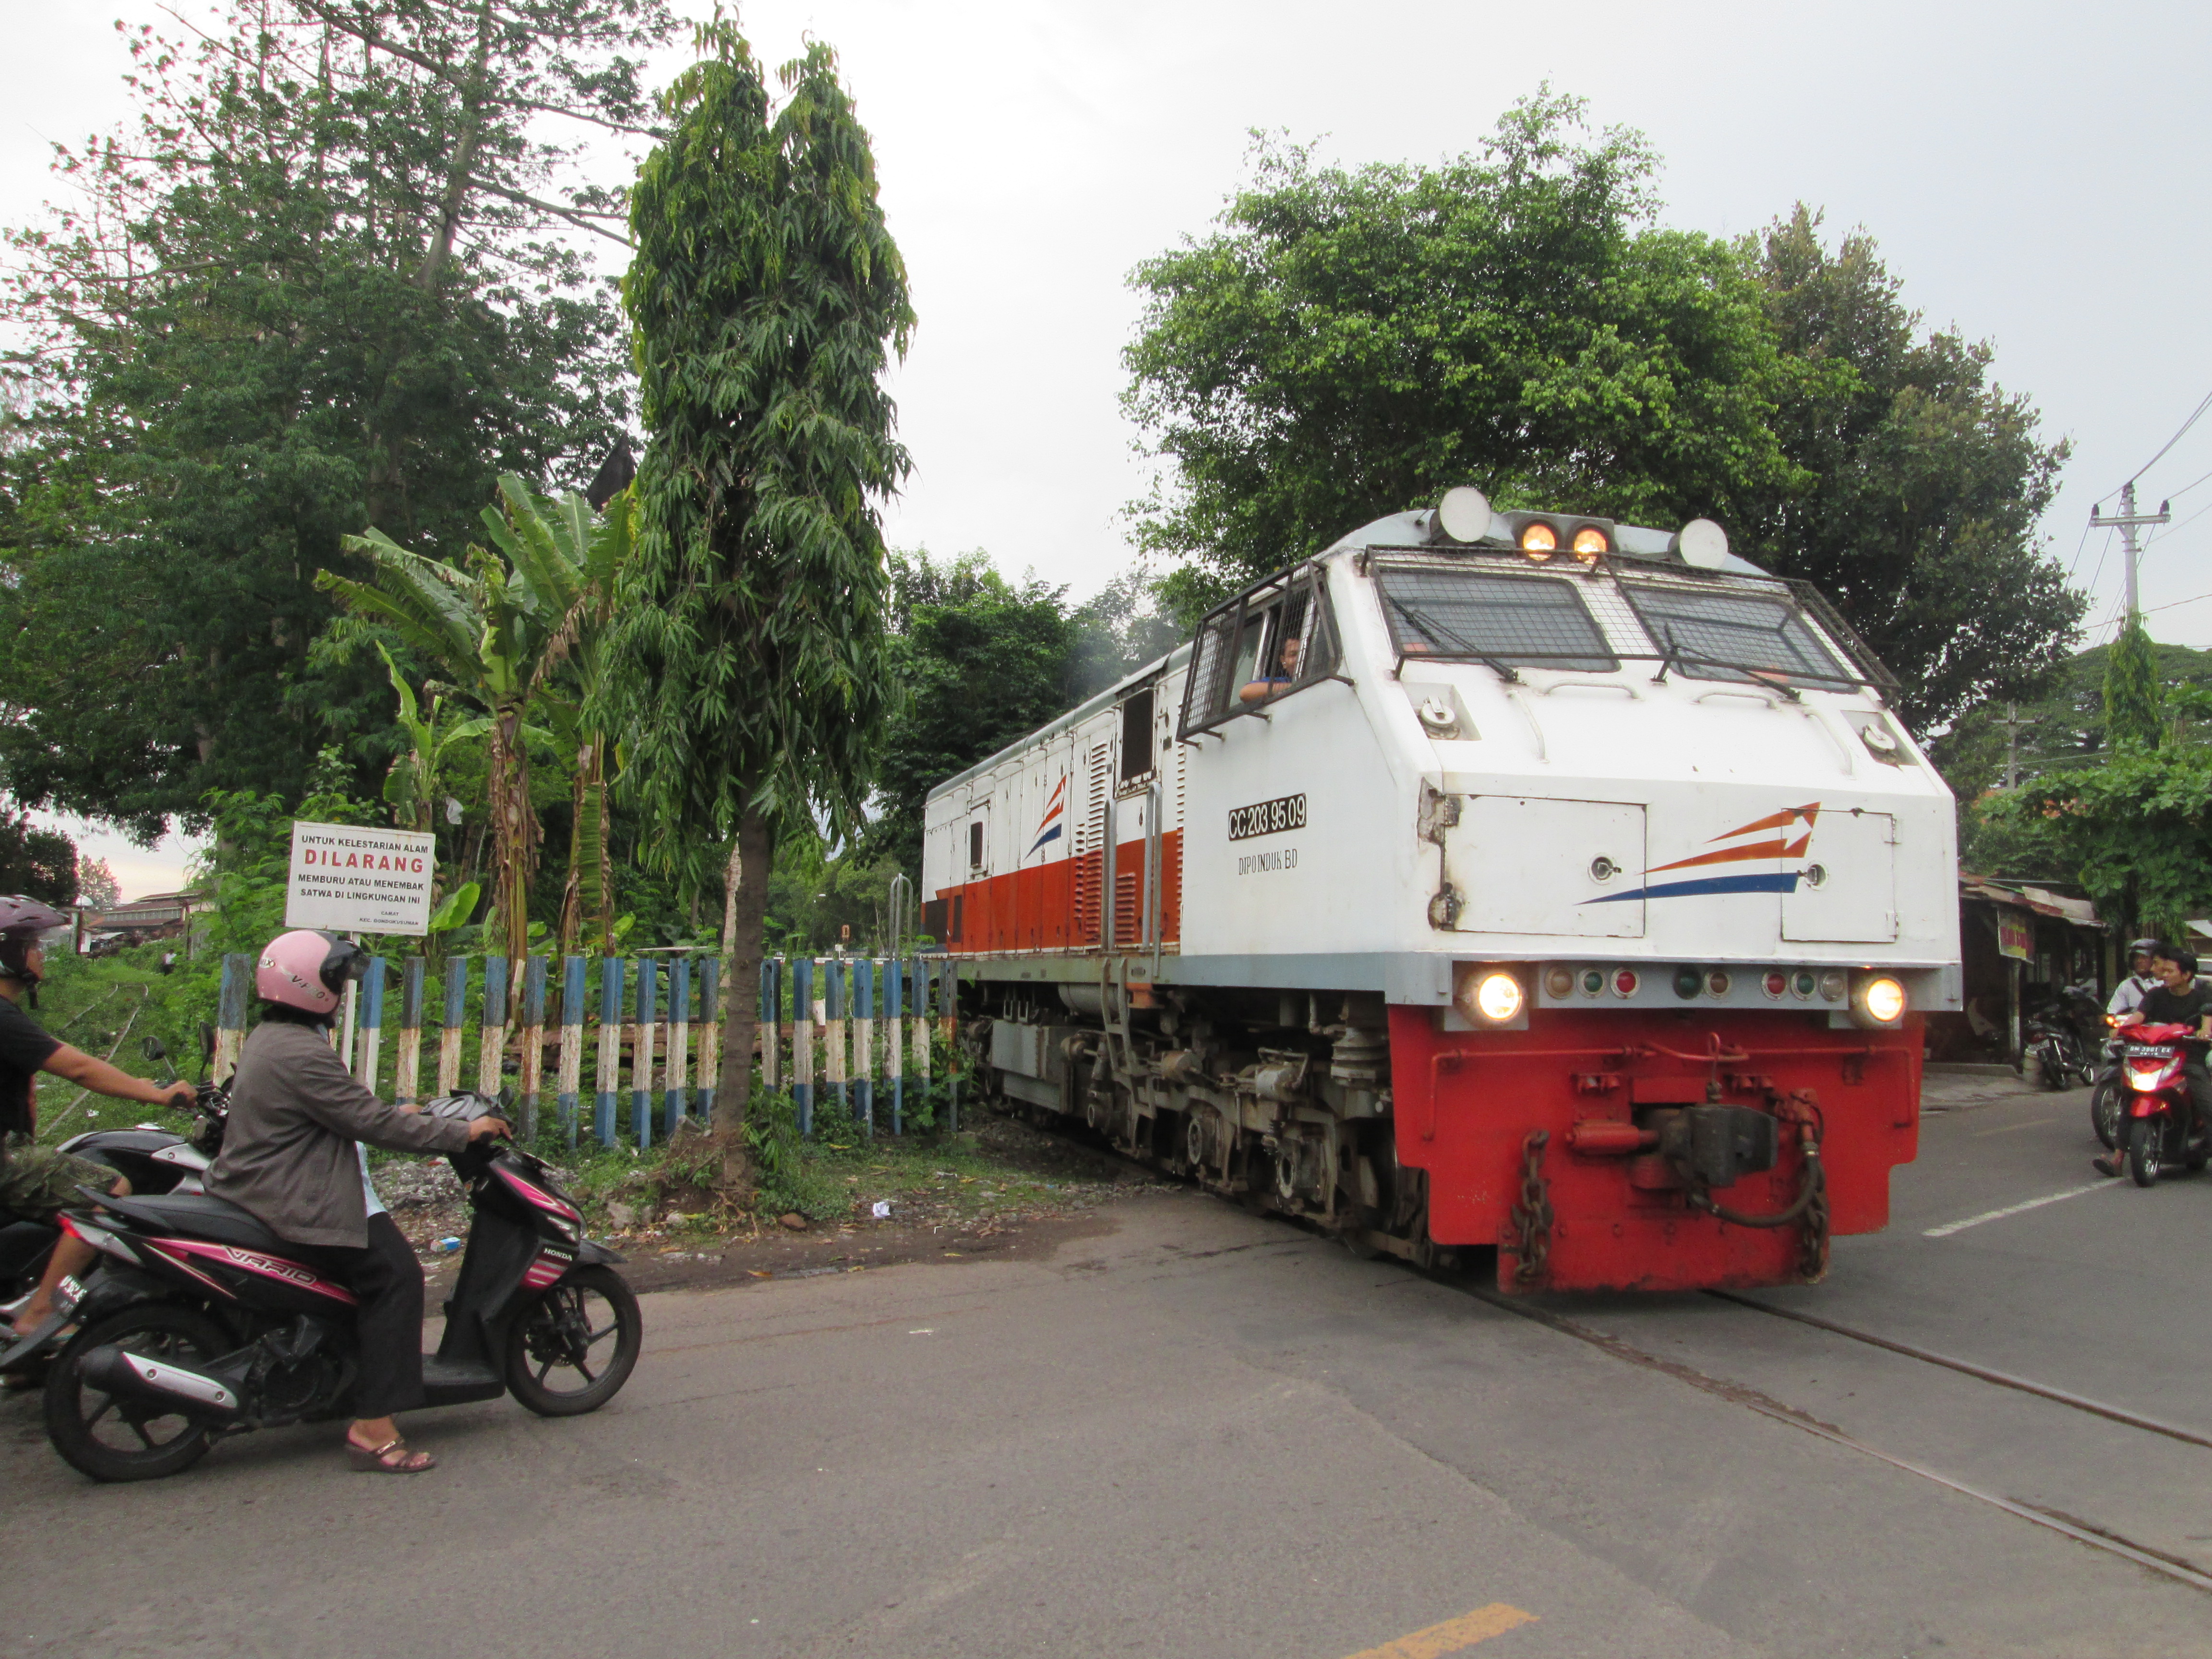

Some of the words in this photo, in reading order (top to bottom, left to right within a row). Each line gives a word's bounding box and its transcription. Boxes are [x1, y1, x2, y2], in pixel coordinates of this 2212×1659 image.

[1229, 810, 1246, 838] CC
[1248, 805, 1268, 835] 203
[1272, 801, 1286, 830] 95
[301, 835, 335, 845] UNTUK
[338, 838, 401, 851] KELESTARIAN
[403, 844, 428, 853] ALAM
[304, 849, 423, 873] DILARANG
[1239, 855, 1256, 875] DIPO
[1258, 851, 1282, 872] INDUK
[1285, 849, 1298, 868] BD
[298, 874, 346, 884] MEMBURU
[348, 878, 371, 886] ATAU
[374, 880, 424, 890] MENEMBAK
[301, 889, 332, 898] SATWA
[347, 891, 406, 902] LINGKUNGAN
[222, 1244, 317, 1285] VARIO
[543, 1248, 572, 1262] HONDA
